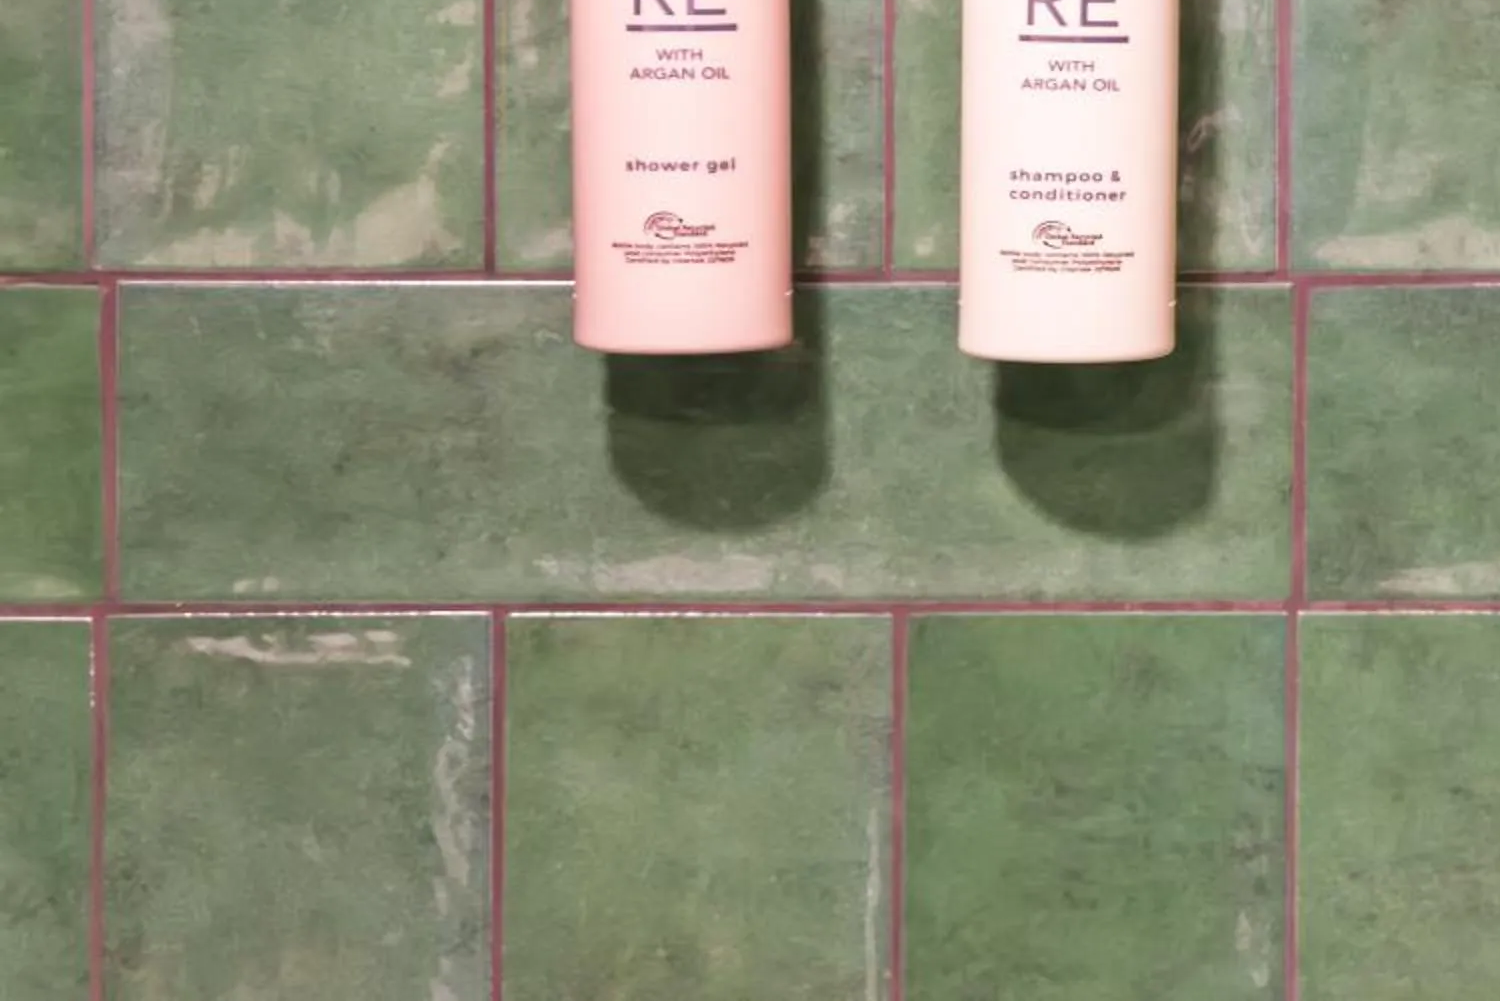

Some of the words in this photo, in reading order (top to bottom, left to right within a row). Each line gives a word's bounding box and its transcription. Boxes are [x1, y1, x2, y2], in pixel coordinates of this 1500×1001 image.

[655, 48, 703, 61] WITH
[1048, 59, 1095, 72] WITH
[629, 67, 696, 80] ARGAN
[700, 66, 730, 80] OIL
[1020, 77, 1087, 91] ARGAN
[1092, 78, 1121, 92] OIL
[625, 158, 699, 172] shower
[706, 157, 736, 174] gel
[1009, 169, 1103, 185] shampoo
[1110, 170, 1121, 183] &
[1009, 189, 1127, 202] conditioner
